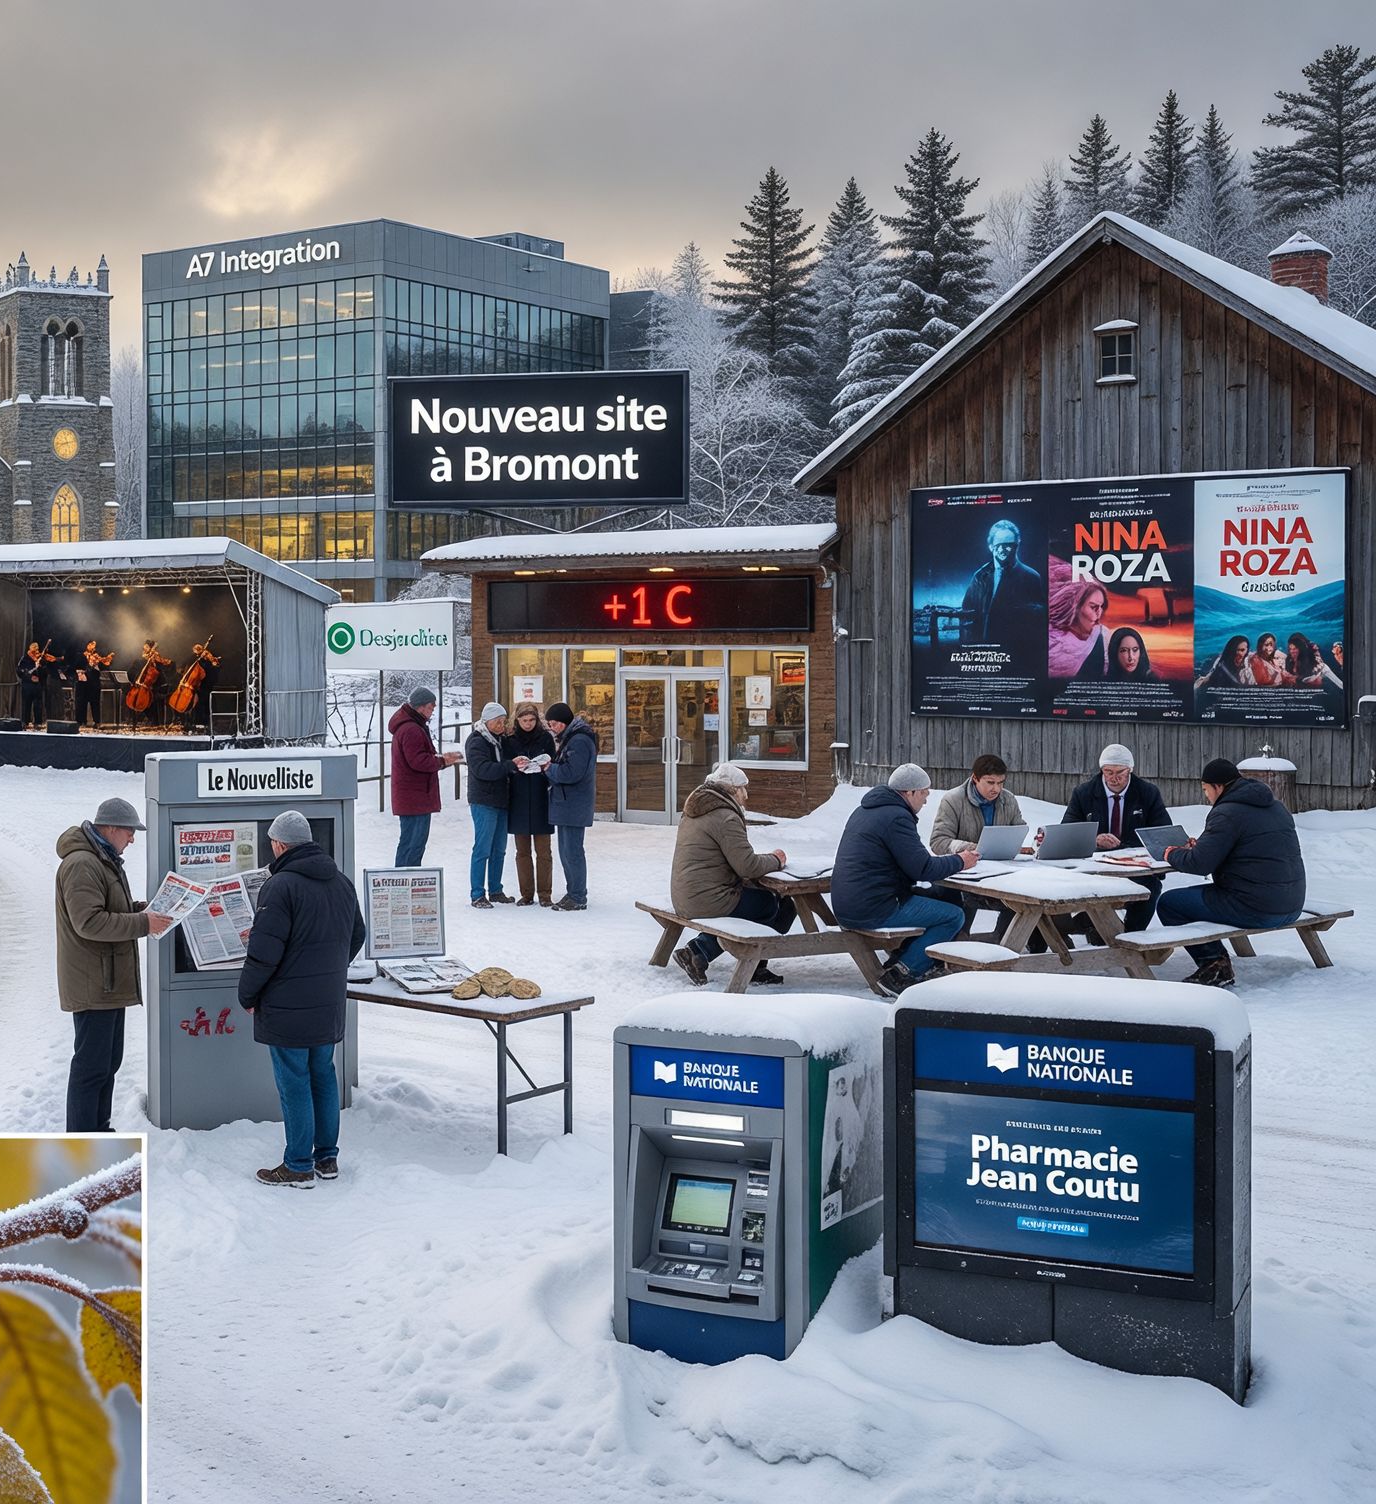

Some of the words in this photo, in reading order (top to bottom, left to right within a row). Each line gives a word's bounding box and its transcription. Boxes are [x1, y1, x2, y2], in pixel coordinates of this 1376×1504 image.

[186, 251, 214, 279] A7
[220, 238, 340, 275] Integration
[410, 397, 585, 435] Nouveau
[595, 394, 668, 433] site
[430, 447, 453, 483] à
[464, 447, 639, 482] Bromont
[1074, 520, 1168, 552] NINA
[1224, 516, 1314, 546] NINA
[1071, 552, 1172, 584] ROZA
[1220, 547, 1318, 577] ROZA
[604, 586, 652, 625] +1
[666, 585, 692, 624] C
[207, 768, 224, 791] Le
[227, 766, 314, 790] Nouvelliste
[683, 1061, 740, 1078] BANQUE
[1025, 1044, 1107, 1066] BANQUE
[683, 1075, 759, 1094] NATIONALE
[1026, 1062, 1133, 1087] NATIONALE
[971, 1134, 1139, 1174] Pharmacie
[966, 1161, 1037, 1192] Jean
[1046, 1169, 1140, 1203] Coutu
